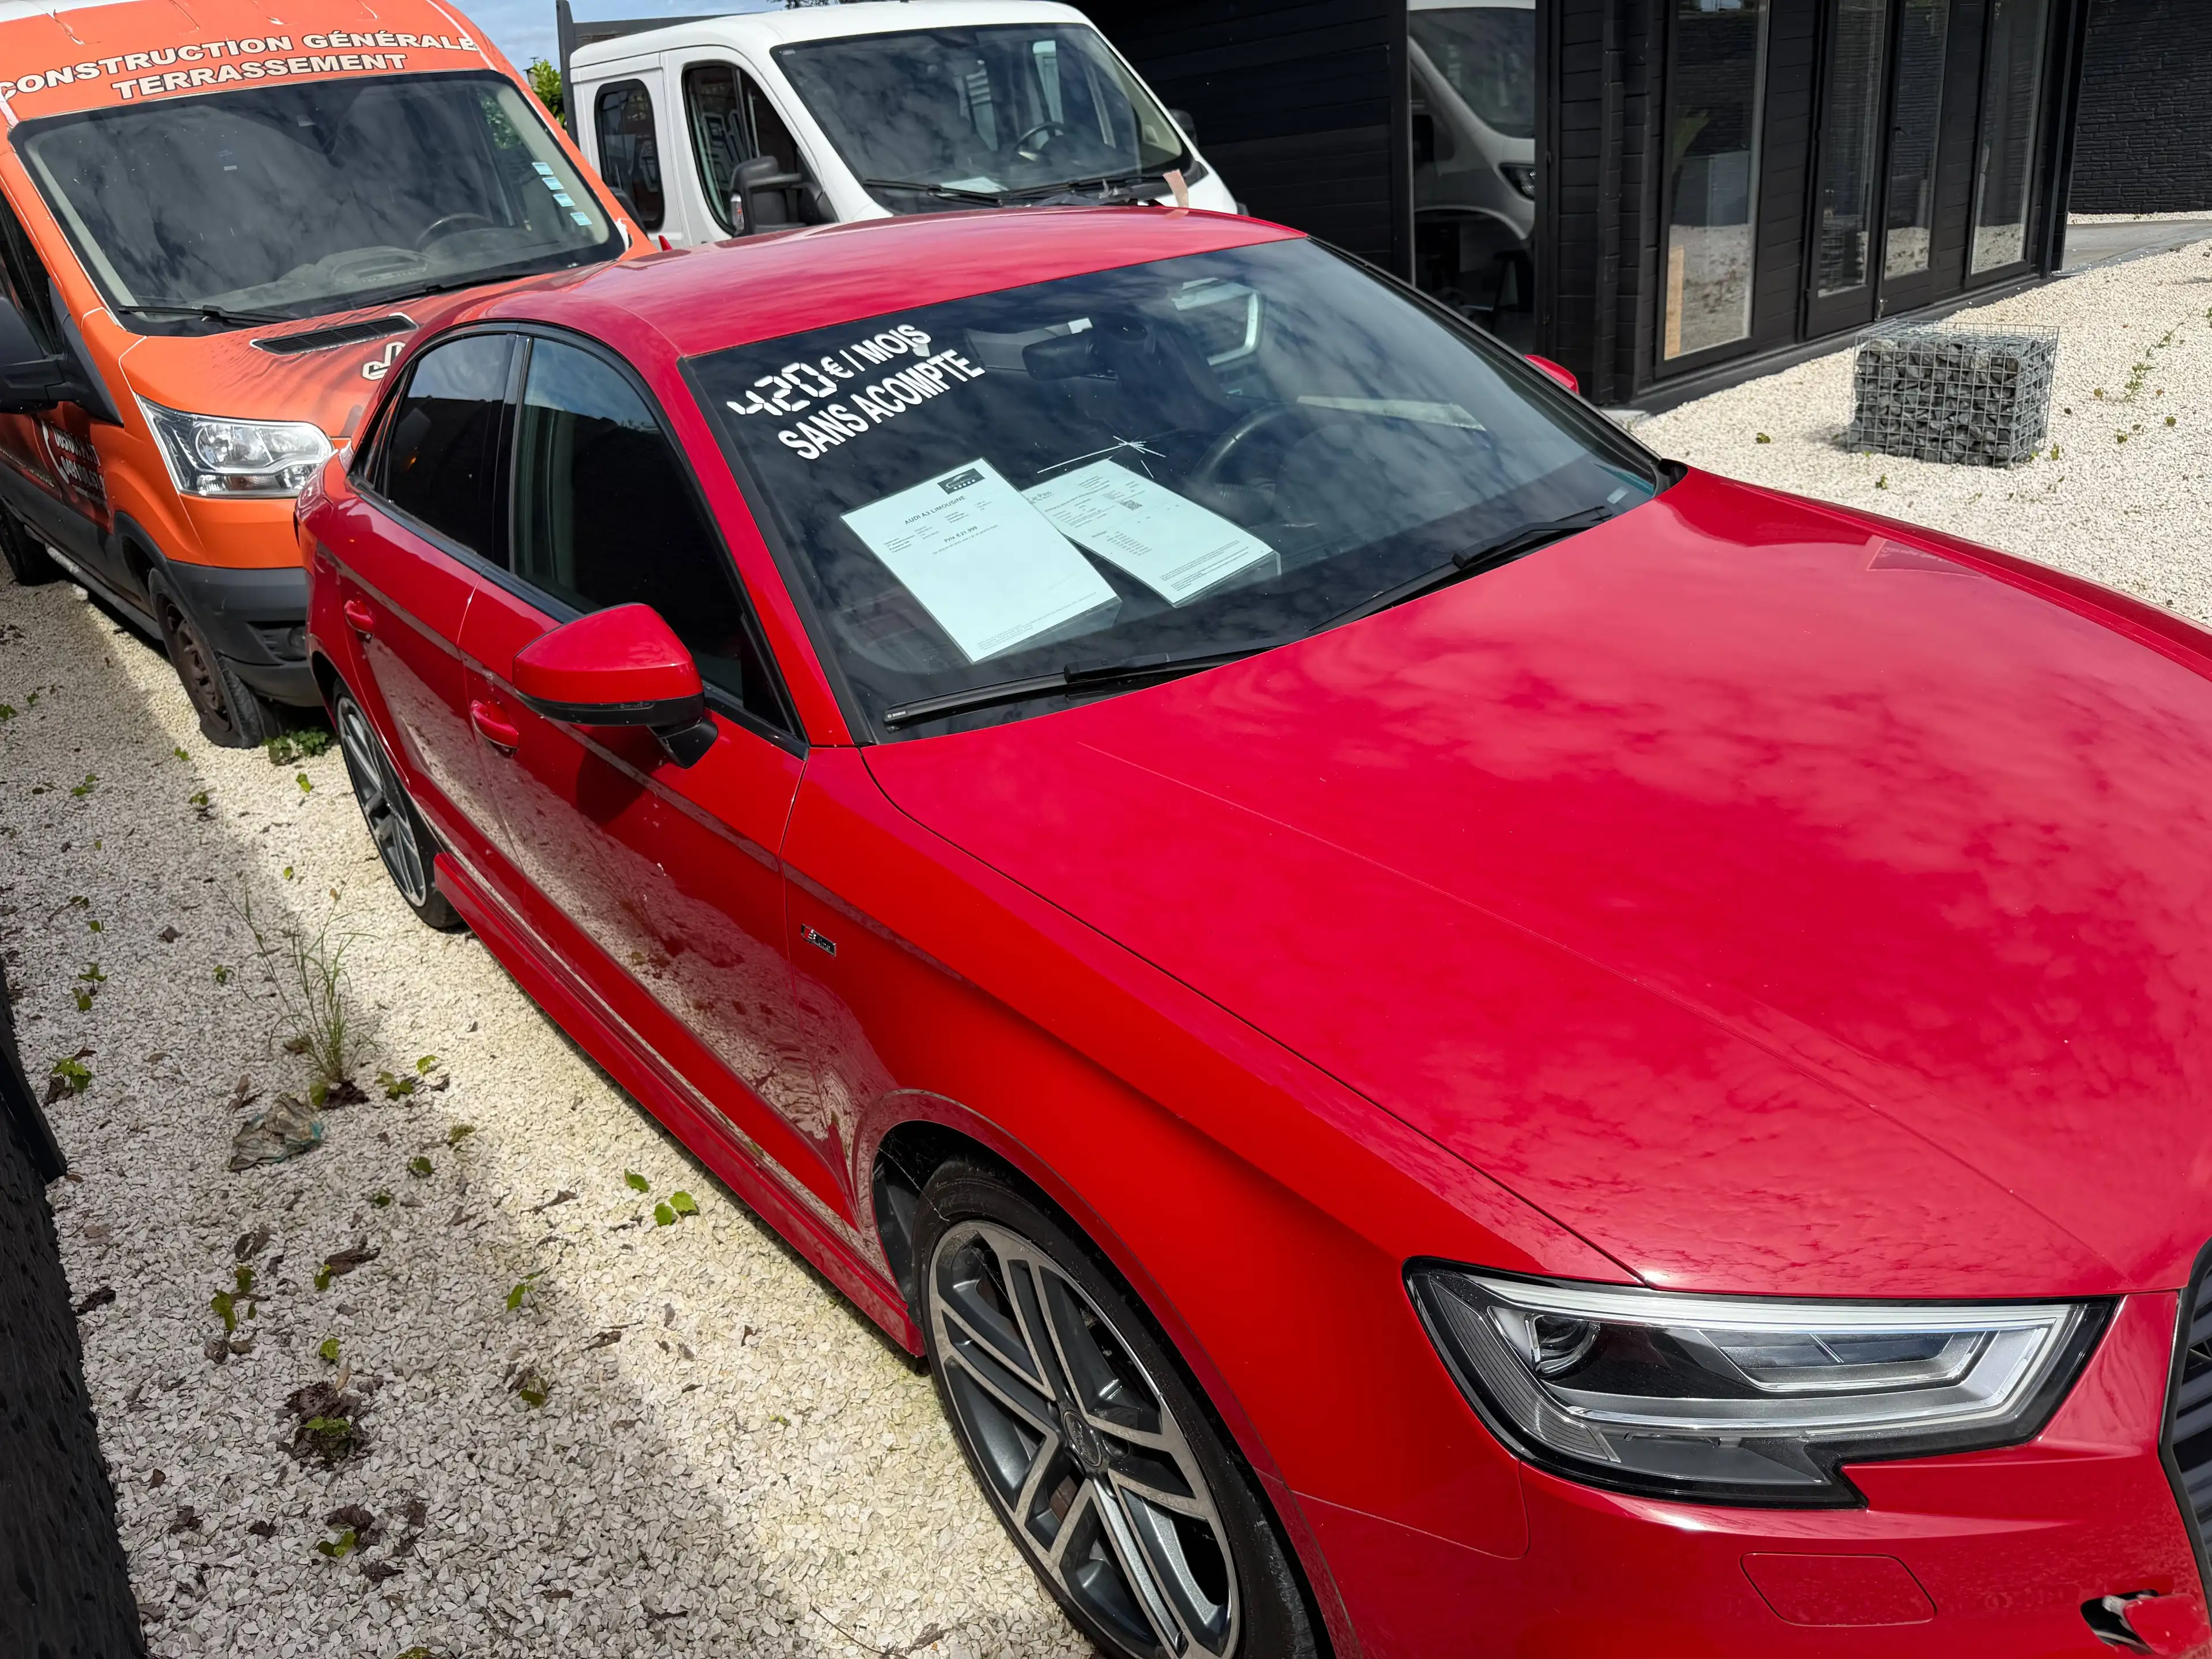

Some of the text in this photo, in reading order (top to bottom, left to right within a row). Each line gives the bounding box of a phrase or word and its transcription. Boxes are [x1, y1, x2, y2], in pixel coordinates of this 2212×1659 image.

[302, 30, 479, 52] GÉNÉRALE
[112, 54, 407, 100] TERRASSEMENT
[851, 324, 931, 365] MOIS
[778, 349, 986, 460] SANS ACOMPTE
[904, 514, 922, 525] AUDI
[922, 510, 931, 518] A3
[930, 495, 967, 514] LIMOUSINE
